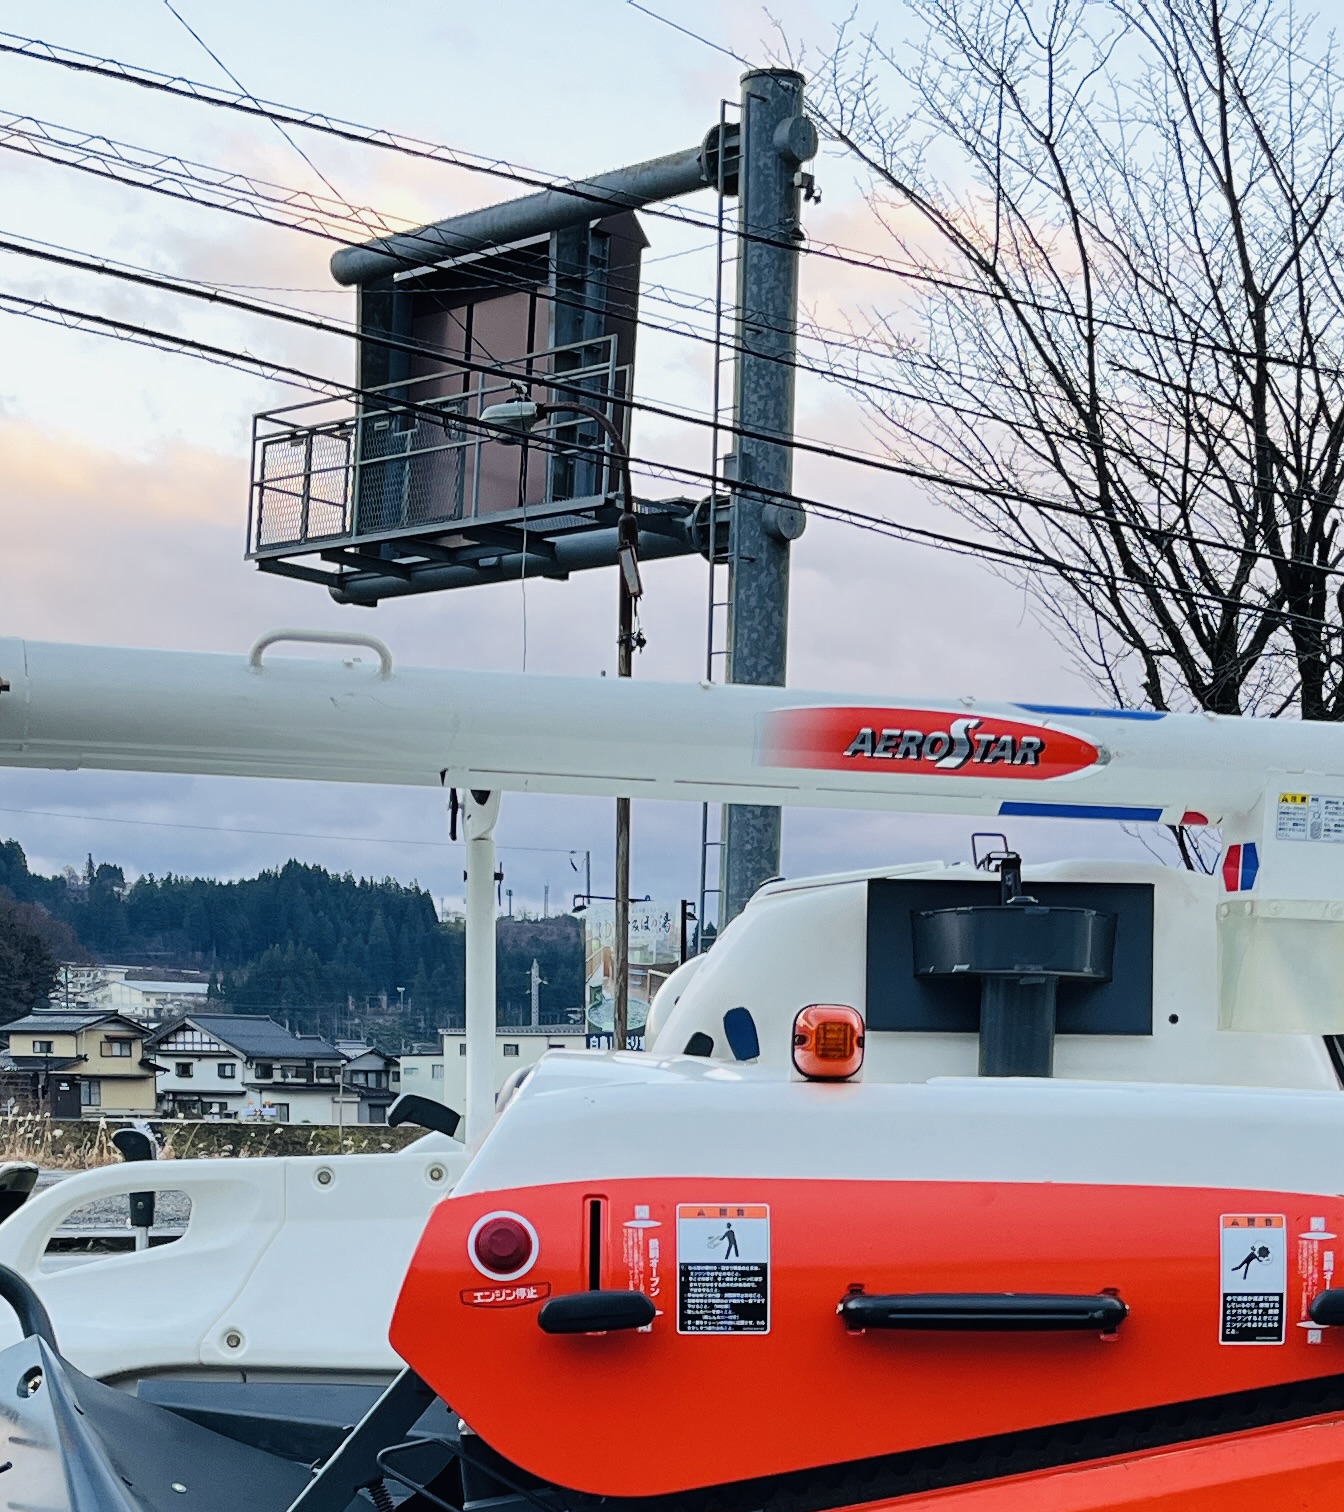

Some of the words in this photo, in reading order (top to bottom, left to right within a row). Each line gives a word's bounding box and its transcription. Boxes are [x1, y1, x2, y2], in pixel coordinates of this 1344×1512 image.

[843, 718, 1045, 769] AEROSTAR
[473, 1286, 539, 1303] エンジン停止
